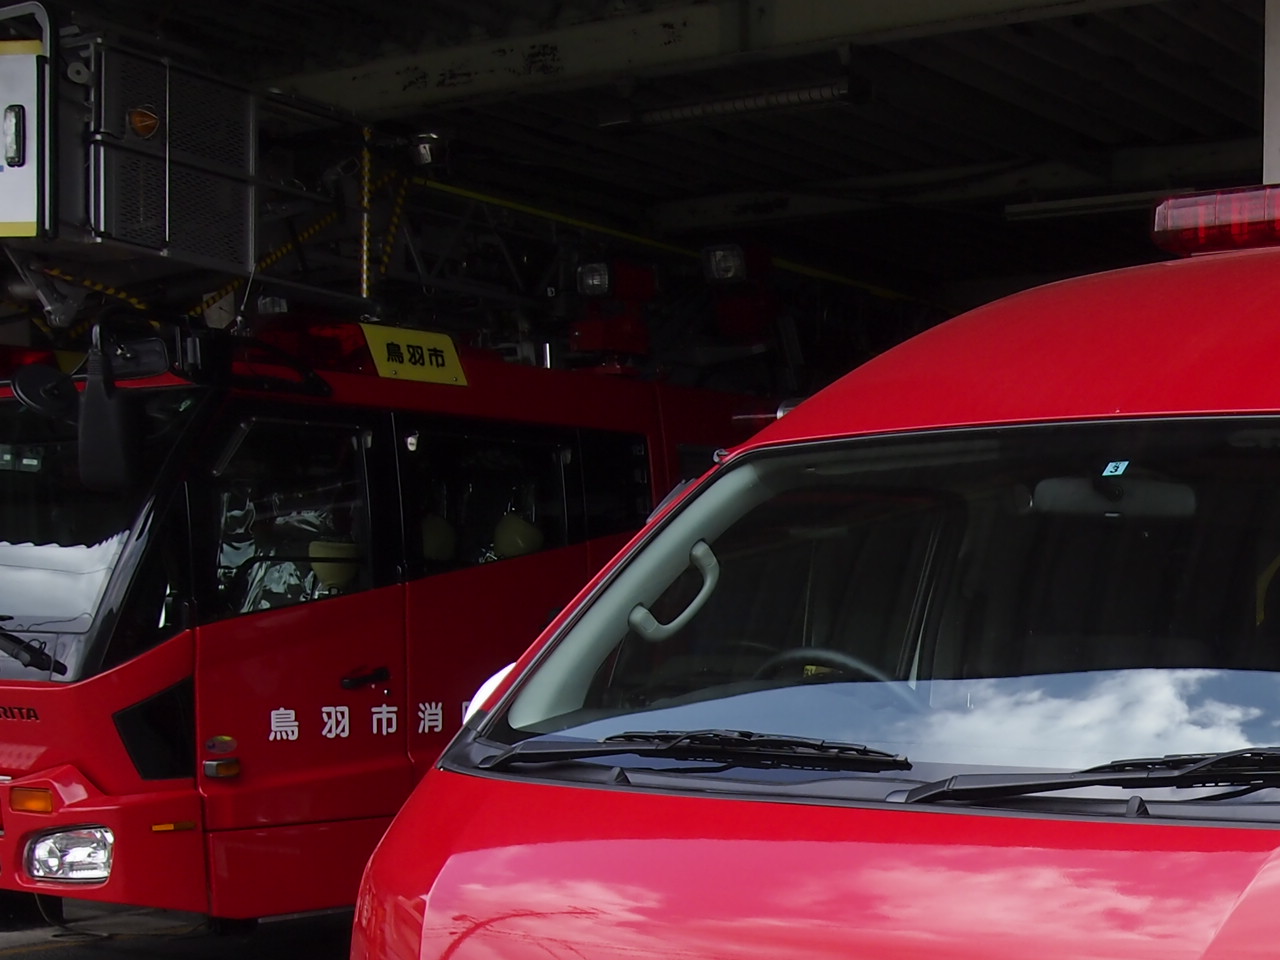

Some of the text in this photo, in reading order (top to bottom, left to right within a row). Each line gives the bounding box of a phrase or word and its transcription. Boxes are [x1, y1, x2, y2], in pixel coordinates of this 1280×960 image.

[386, 342, 446, 368] 鳥羽市
[269, 701, 467, 741] 鳥羽市消
